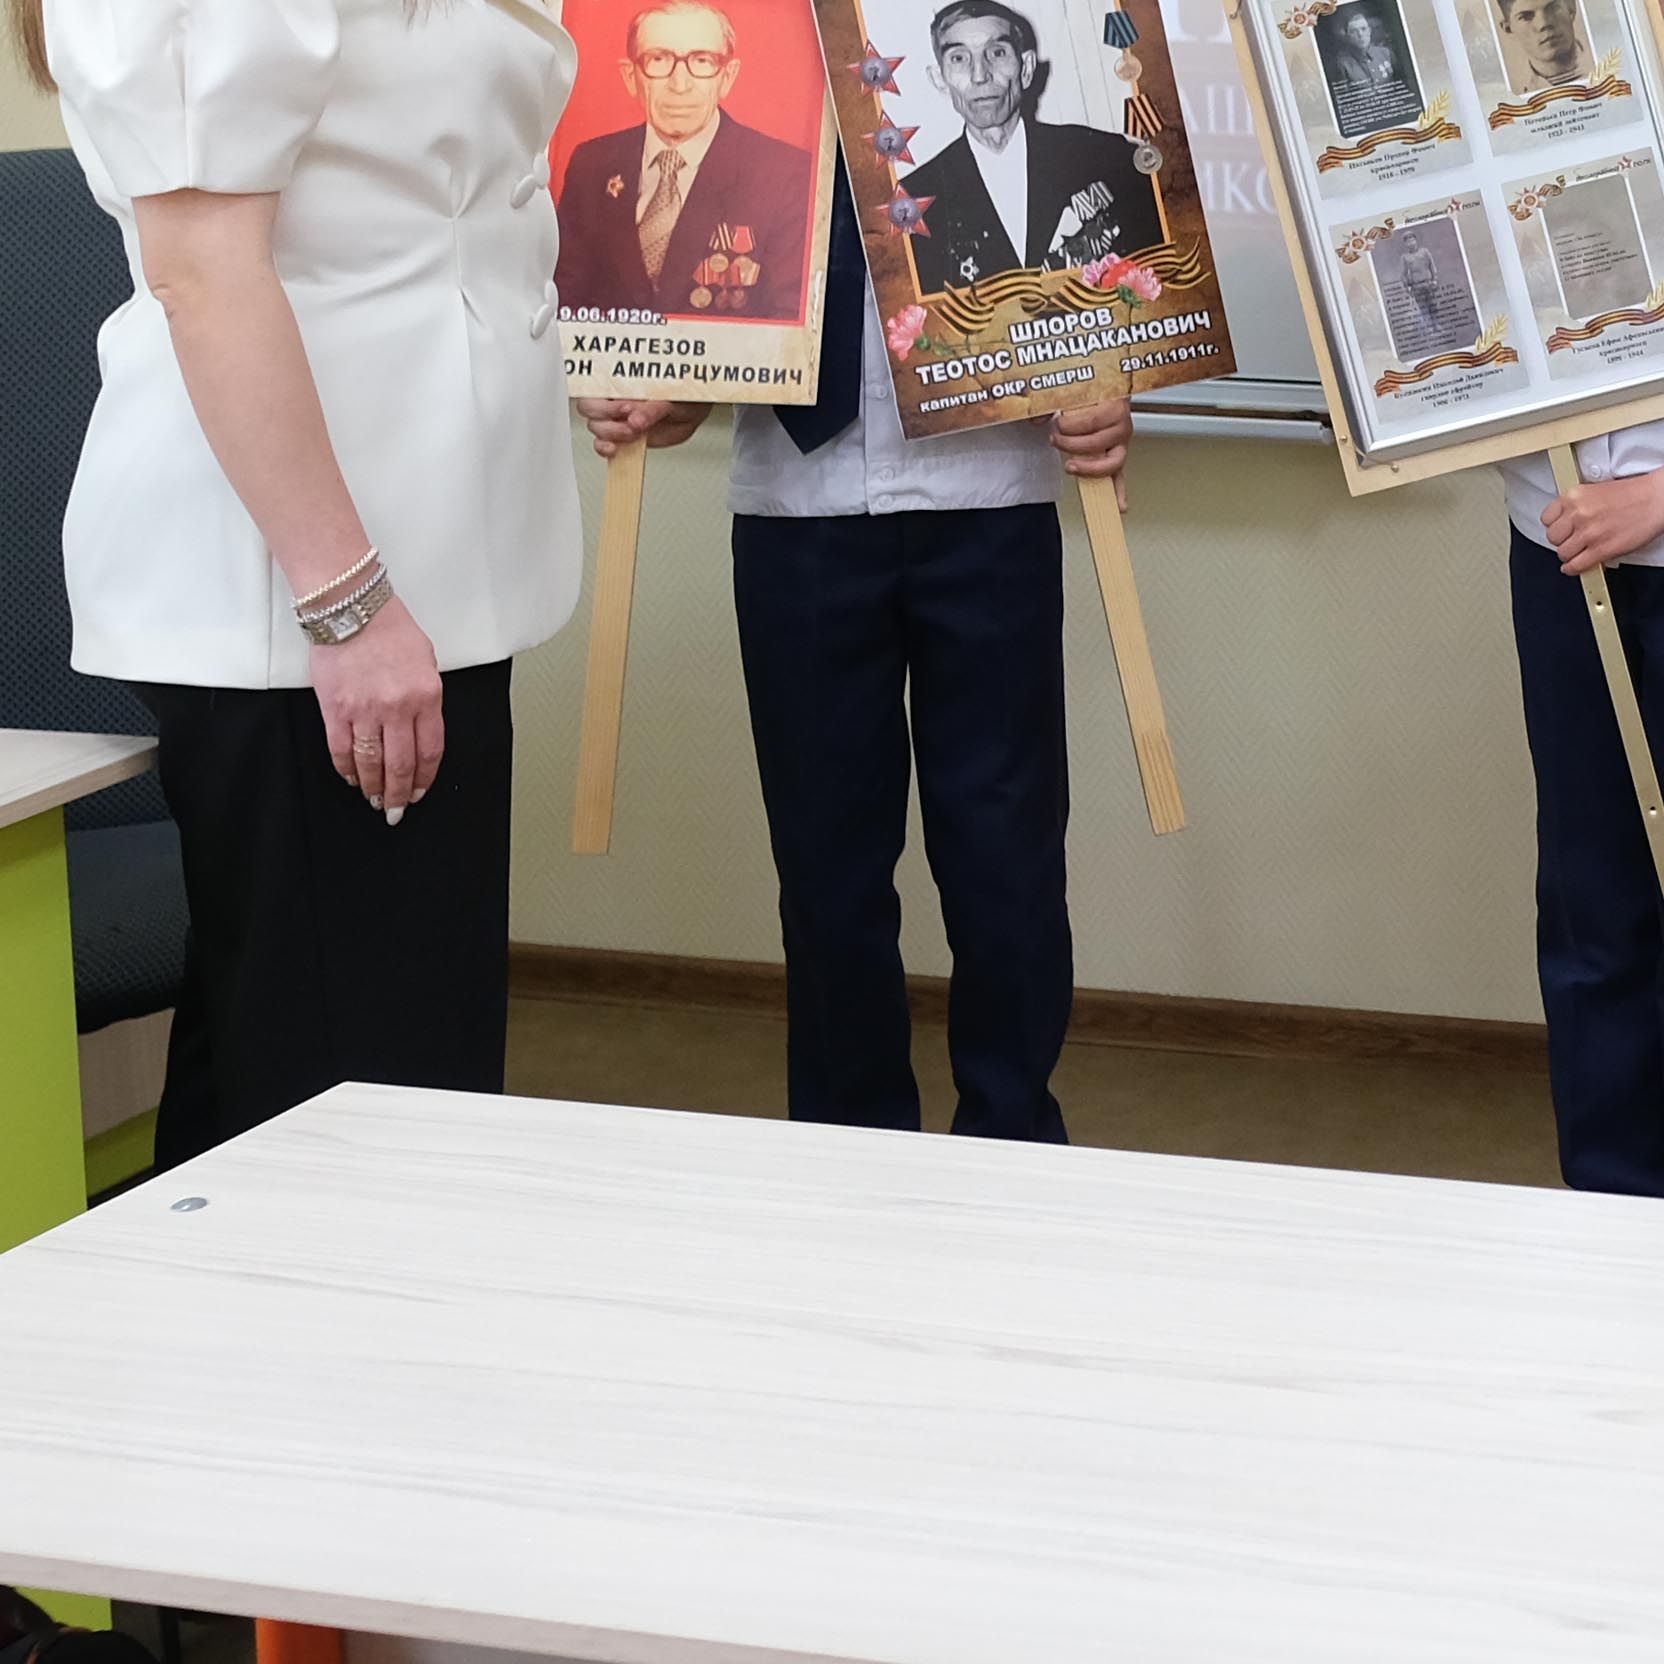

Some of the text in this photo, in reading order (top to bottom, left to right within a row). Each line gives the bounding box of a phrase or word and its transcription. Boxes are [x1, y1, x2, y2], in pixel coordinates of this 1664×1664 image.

[1009, 307, 1114, 344] ШЛОРОВ
[572, 335, 707, 357] ХАРАГЕЗОВ
[915, 310, 1211, 385] ТЕОТОС МНАЦАКАНОВИЧ
[612, 361, 802, 386] АМПАРЦУМОВИЧ
[919, 365, 1095, 413] капитан ОКР СМЕРШ
